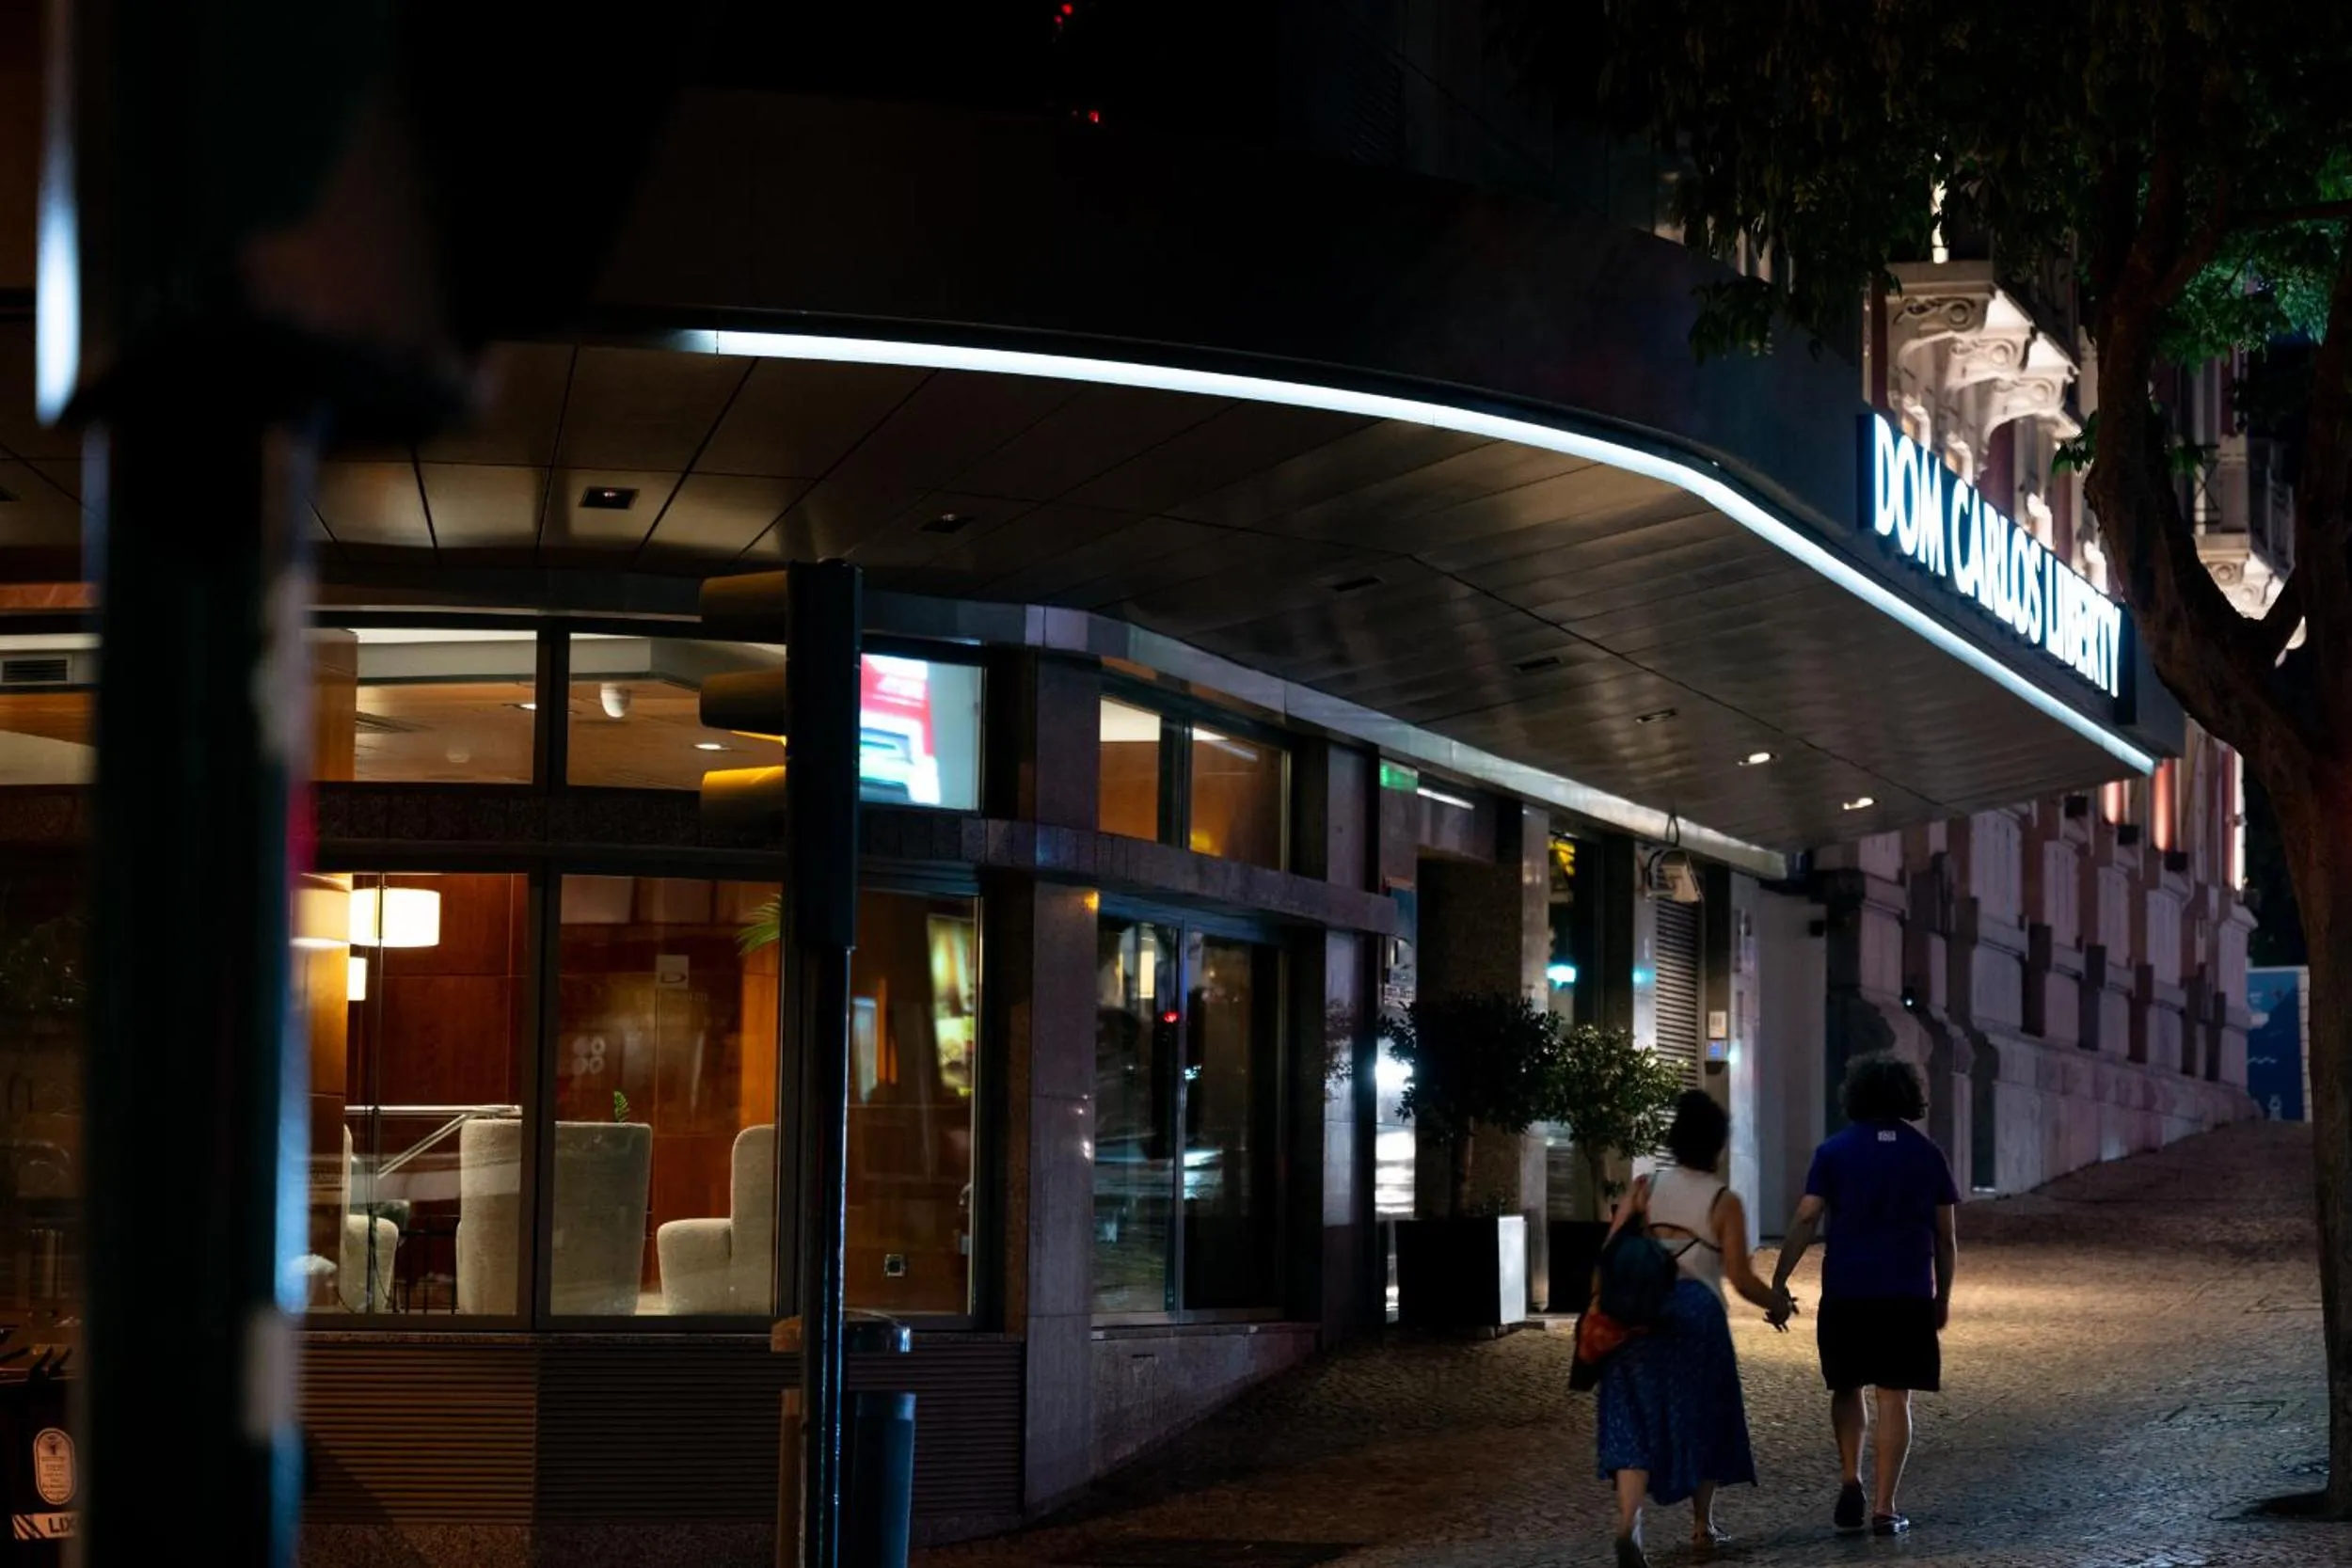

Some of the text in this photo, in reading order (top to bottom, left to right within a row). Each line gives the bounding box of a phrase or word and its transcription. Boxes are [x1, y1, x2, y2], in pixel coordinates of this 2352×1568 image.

[1874, 413, 2121, 698] DOM CARLOS LIBERTY
